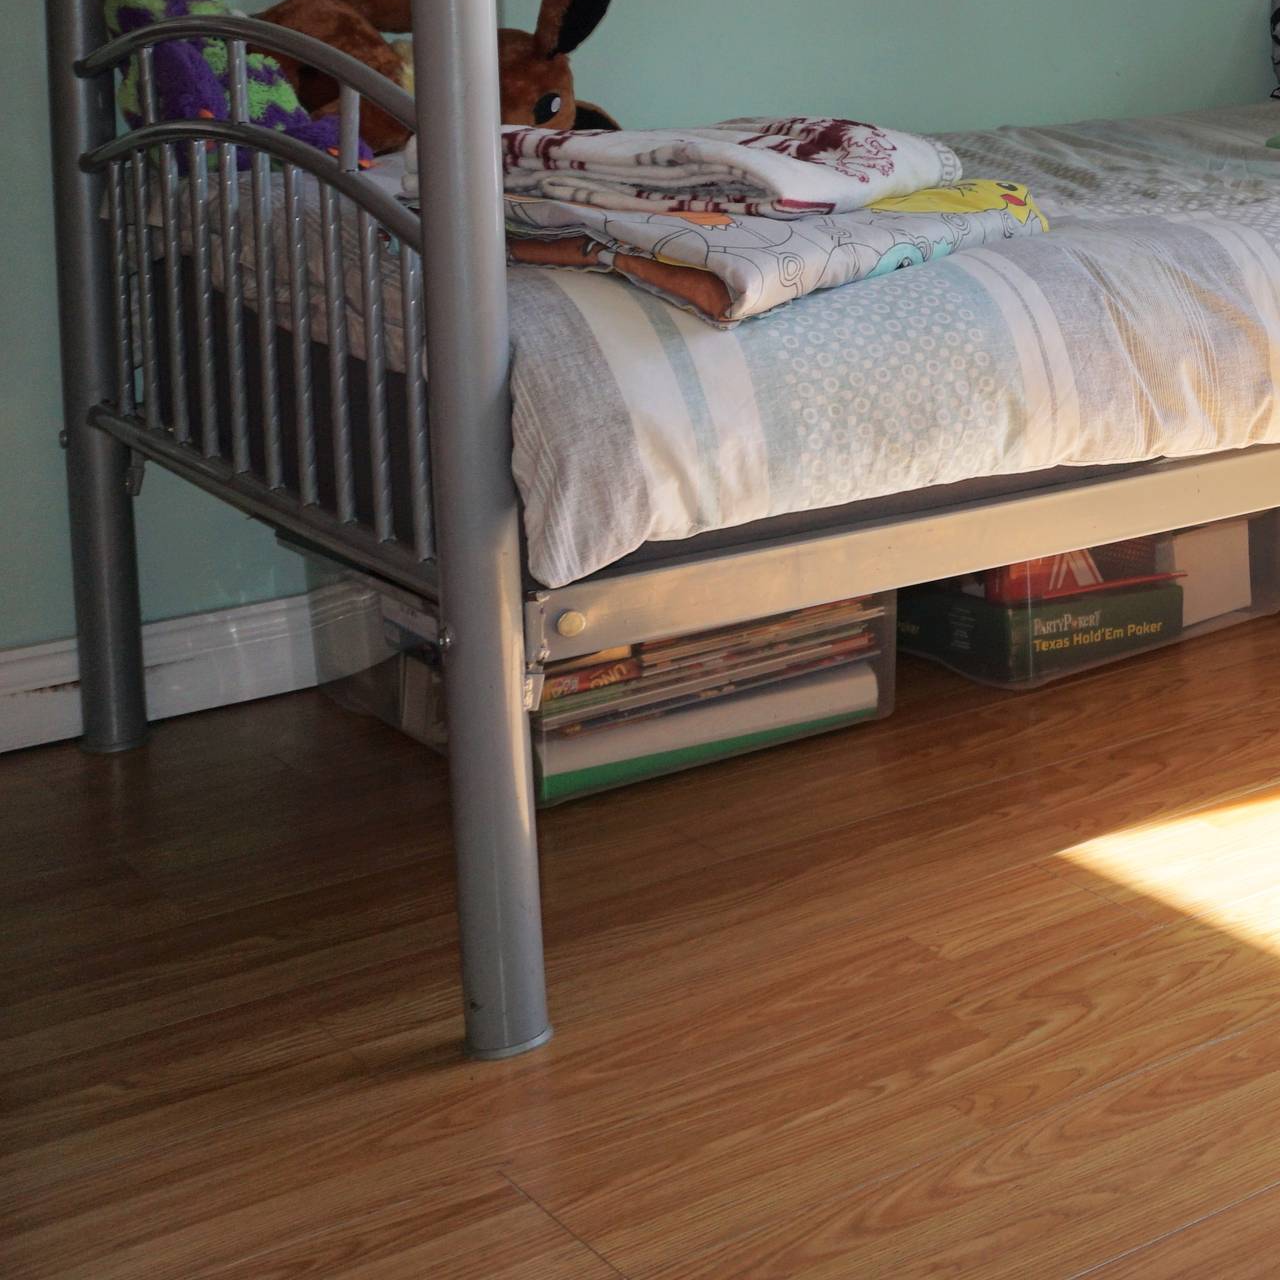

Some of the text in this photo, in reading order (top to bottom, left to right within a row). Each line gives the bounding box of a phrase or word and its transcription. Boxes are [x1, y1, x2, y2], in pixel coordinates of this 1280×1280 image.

[1033, 621, 1163, 652] Texas Hold'Em Poker
